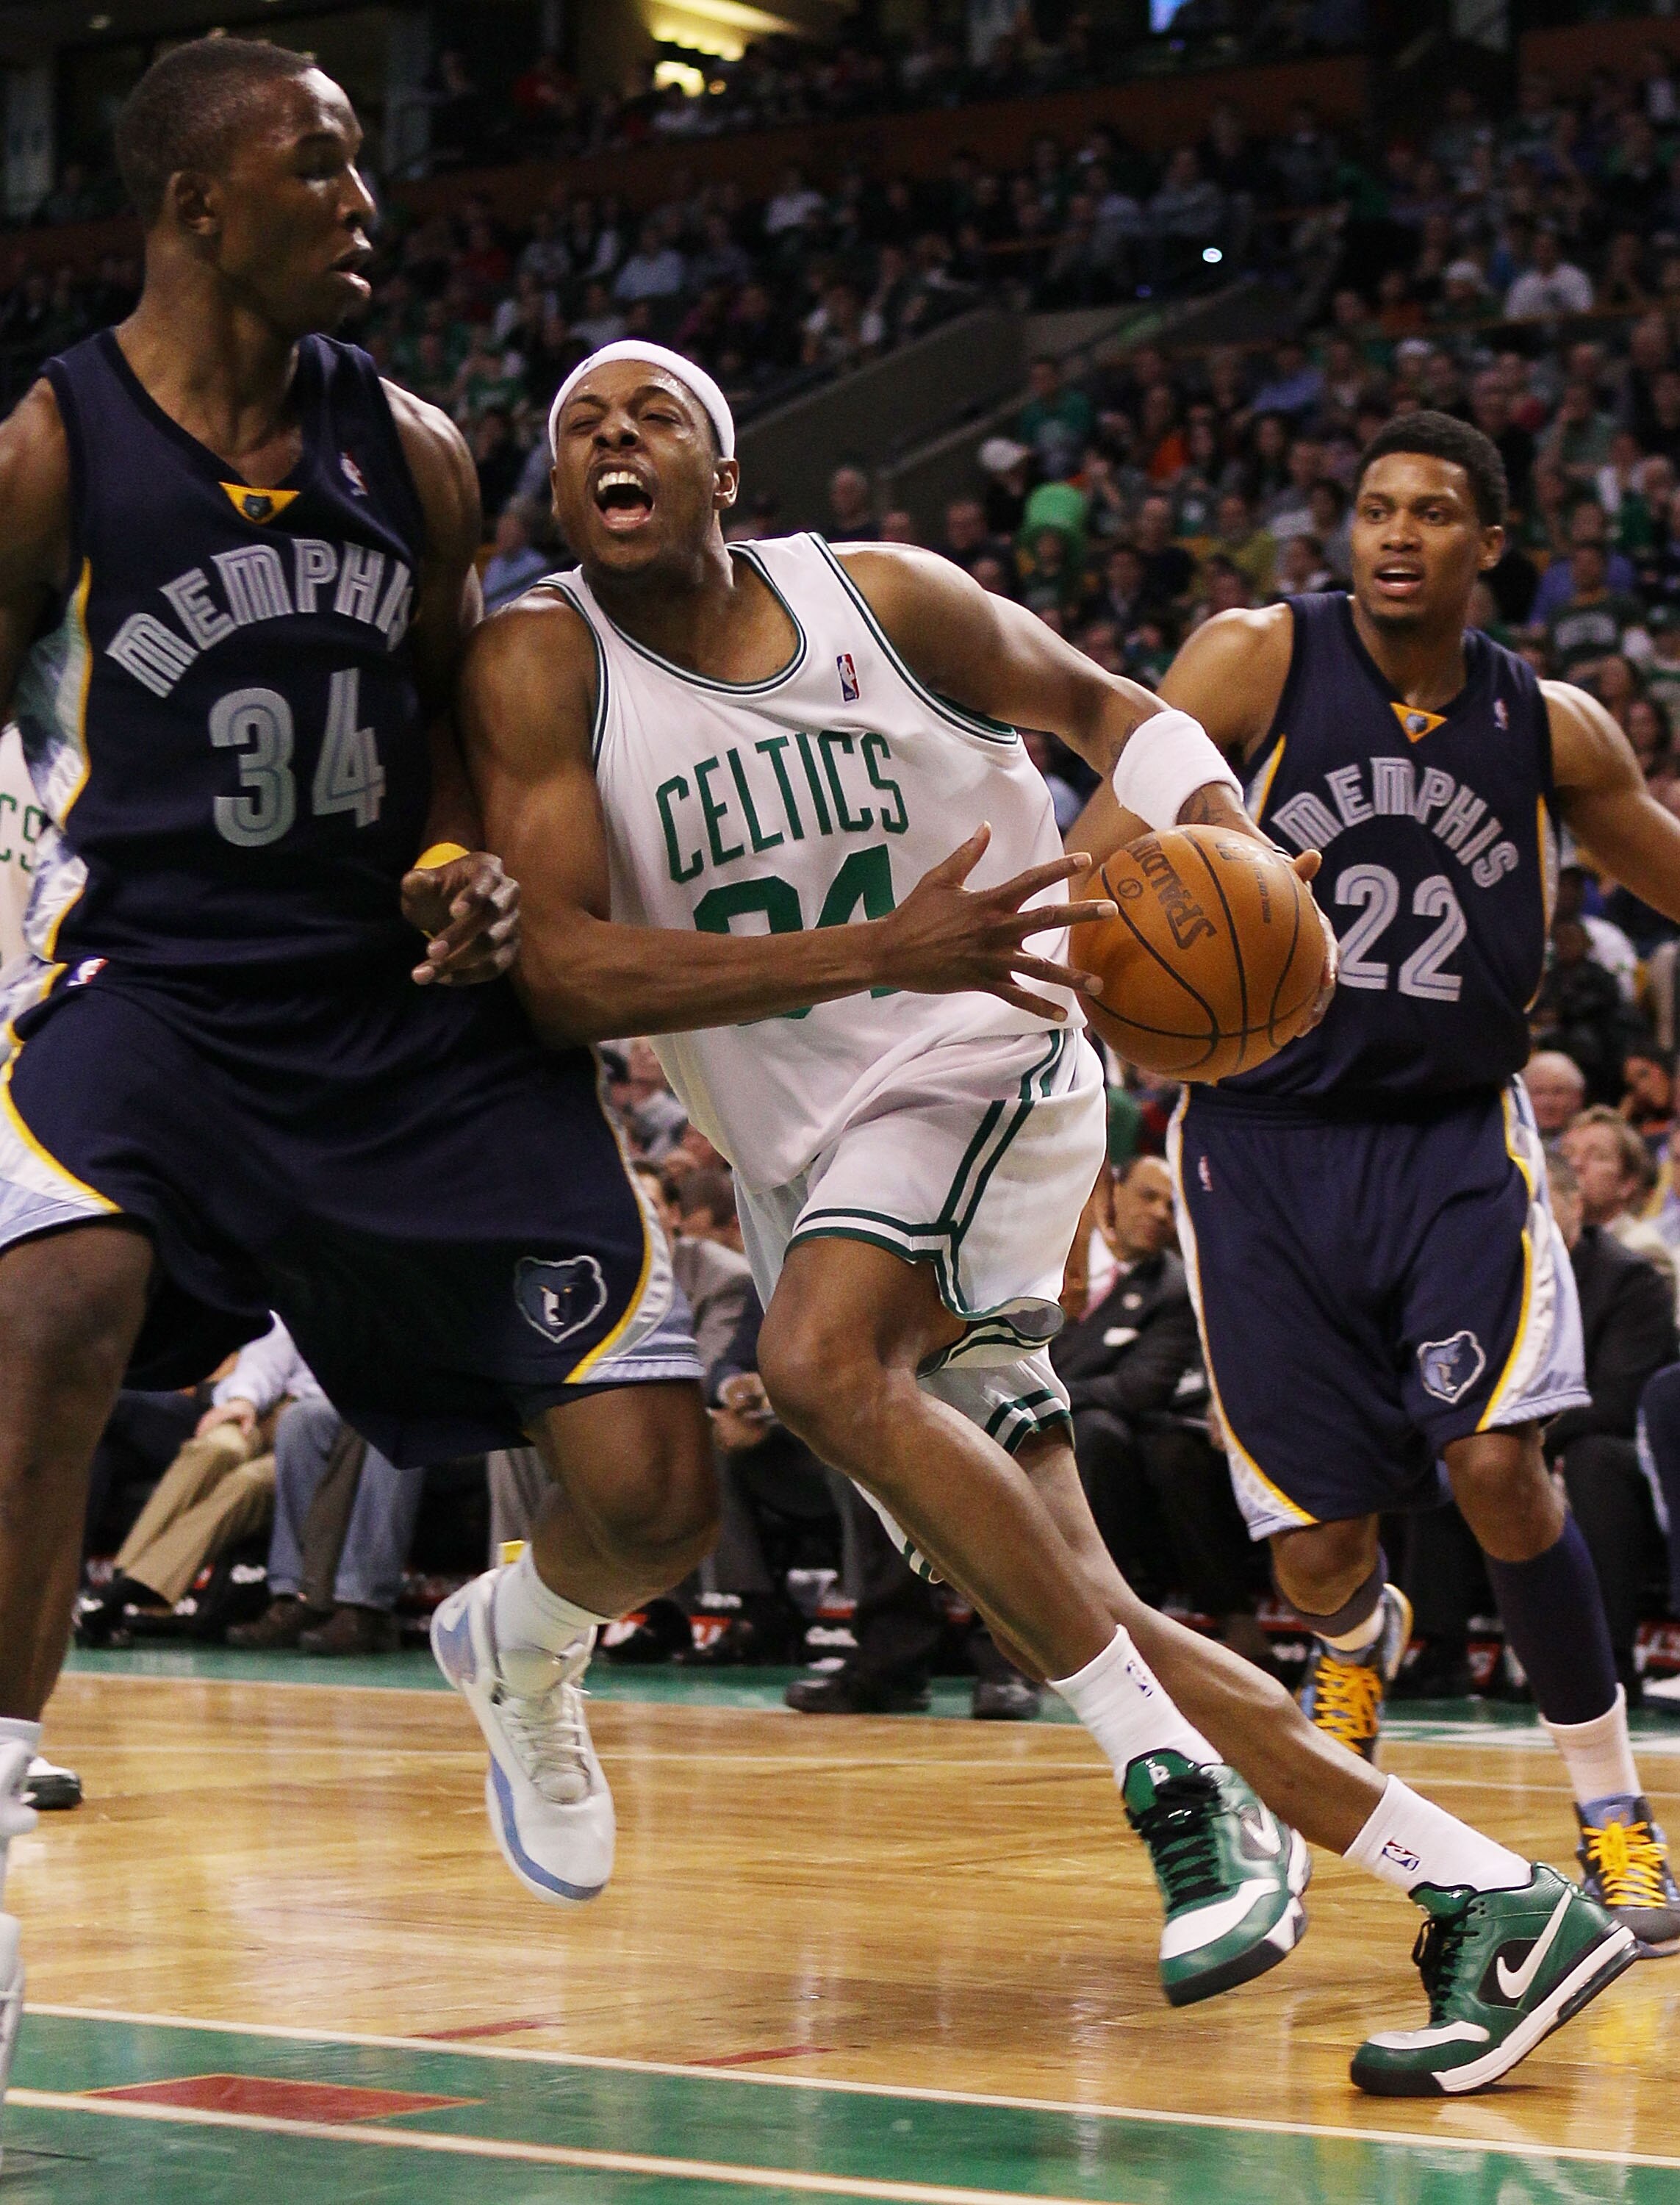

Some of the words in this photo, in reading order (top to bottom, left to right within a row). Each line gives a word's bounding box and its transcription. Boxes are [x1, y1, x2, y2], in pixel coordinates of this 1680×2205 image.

[208, 667, 385, 847] 34
[656, 731, 910, 883] CELTICS
[1271, 756, 1519, 889] MEMPHIS
[1334, 864, 1468, 1002] 22
